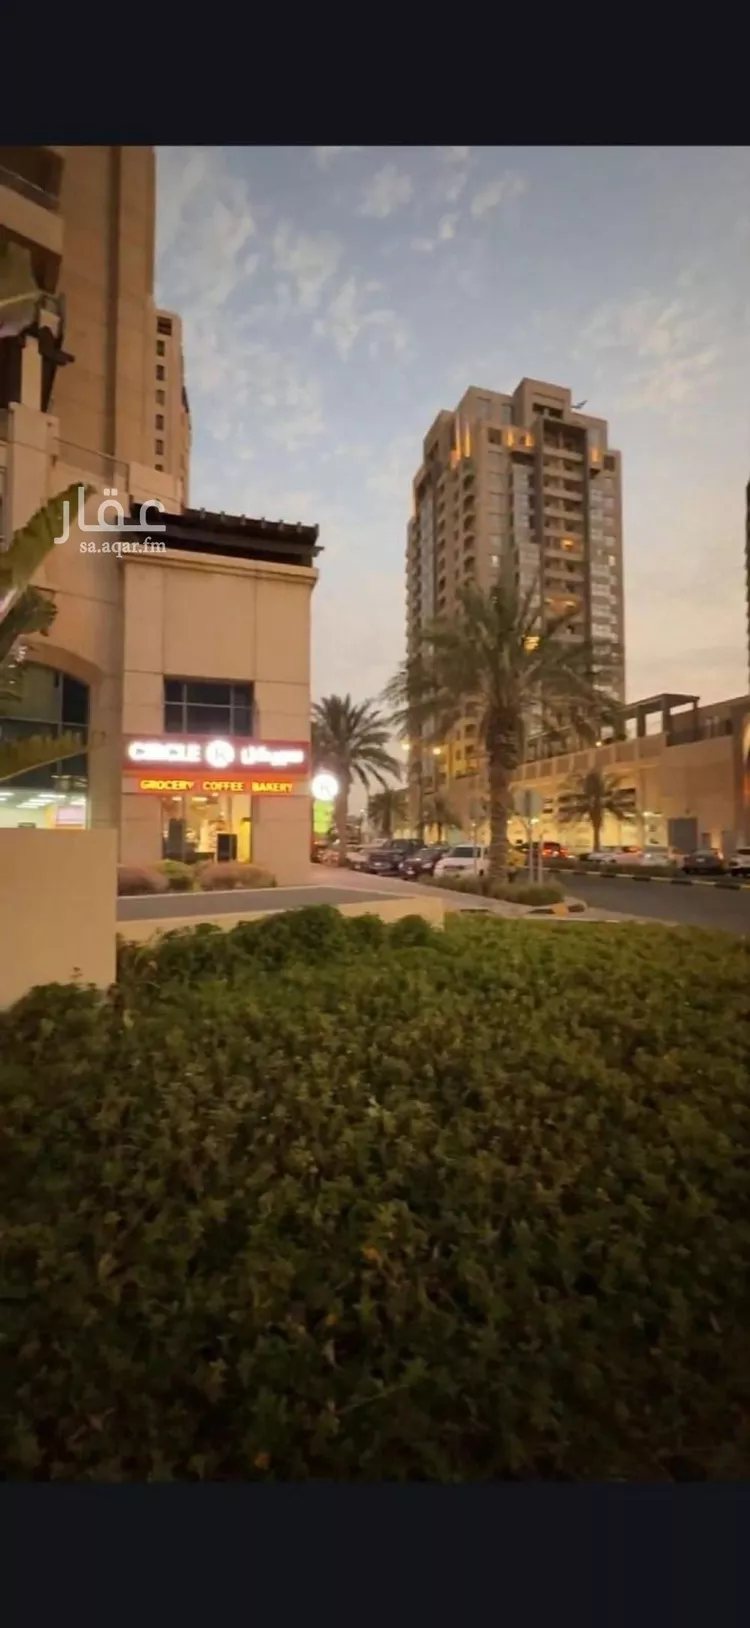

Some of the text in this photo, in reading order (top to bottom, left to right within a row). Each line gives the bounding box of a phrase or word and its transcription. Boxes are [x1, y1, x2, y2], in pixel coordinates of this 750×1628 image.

[129, 742, 201, 762] CIRCLE
[140, 779, 293, 793] GROCERY COFFEE BAKERY
